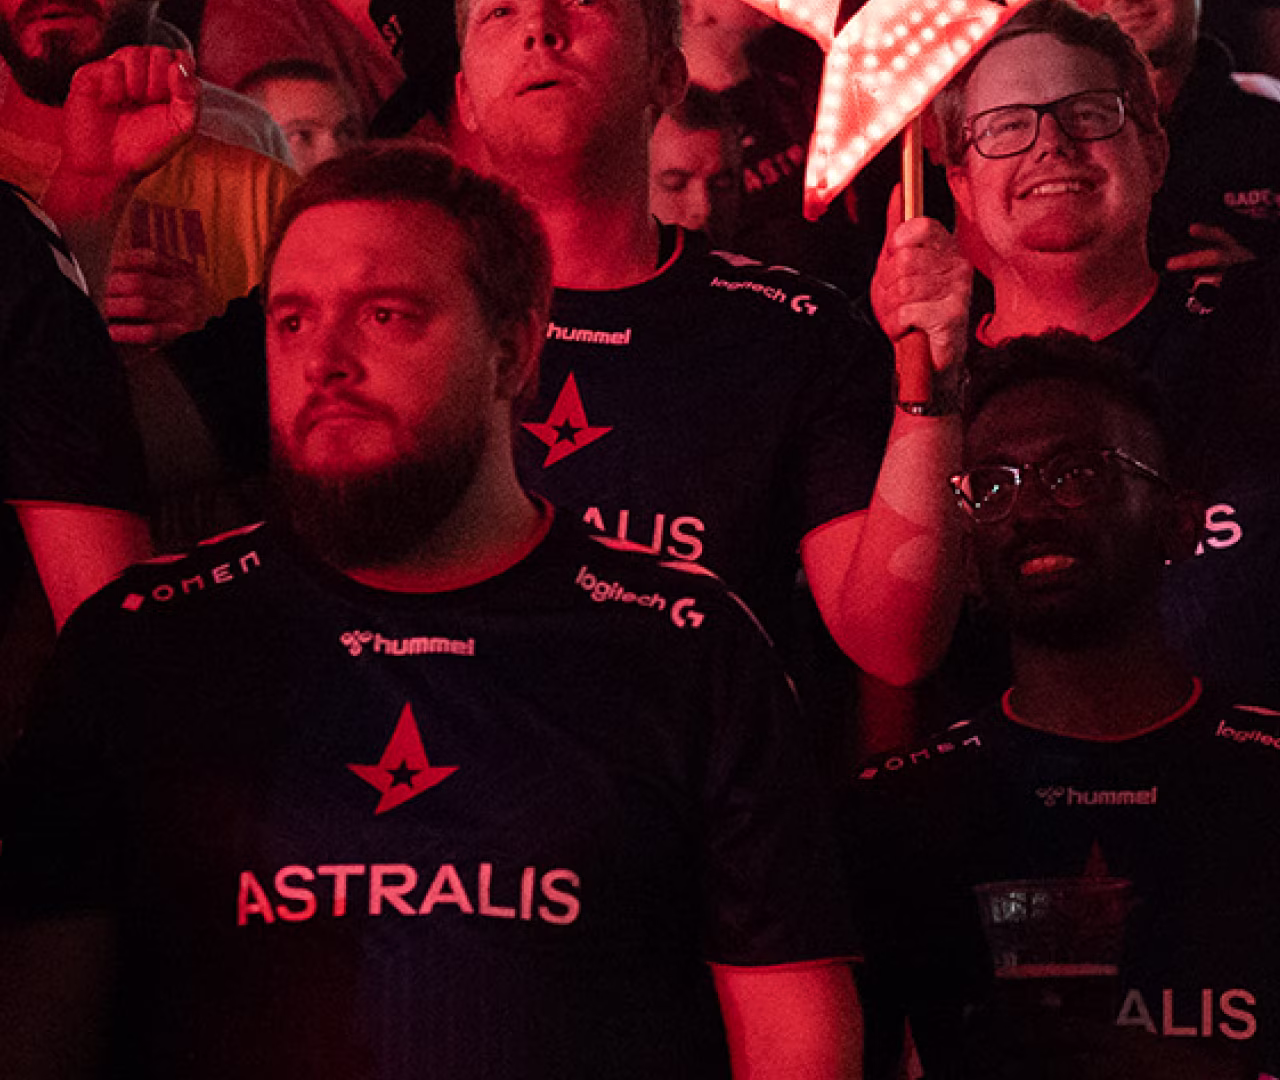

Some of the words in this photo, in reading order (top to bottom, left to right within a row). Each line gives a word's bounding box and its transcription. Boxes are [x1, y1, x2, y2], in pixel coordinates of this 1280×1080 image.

[547, 322, 632, 345] hummel
[152, 550, 261, 603] OMEN
[574, 565, 667, 611] logitech
[373, 632, 477, 657] hummel
[1066, 785, 1160, 807] hummel
[236, 863, 581, 927] ASTRALIS
[1115, 987, 1258, 1041] ALIS
